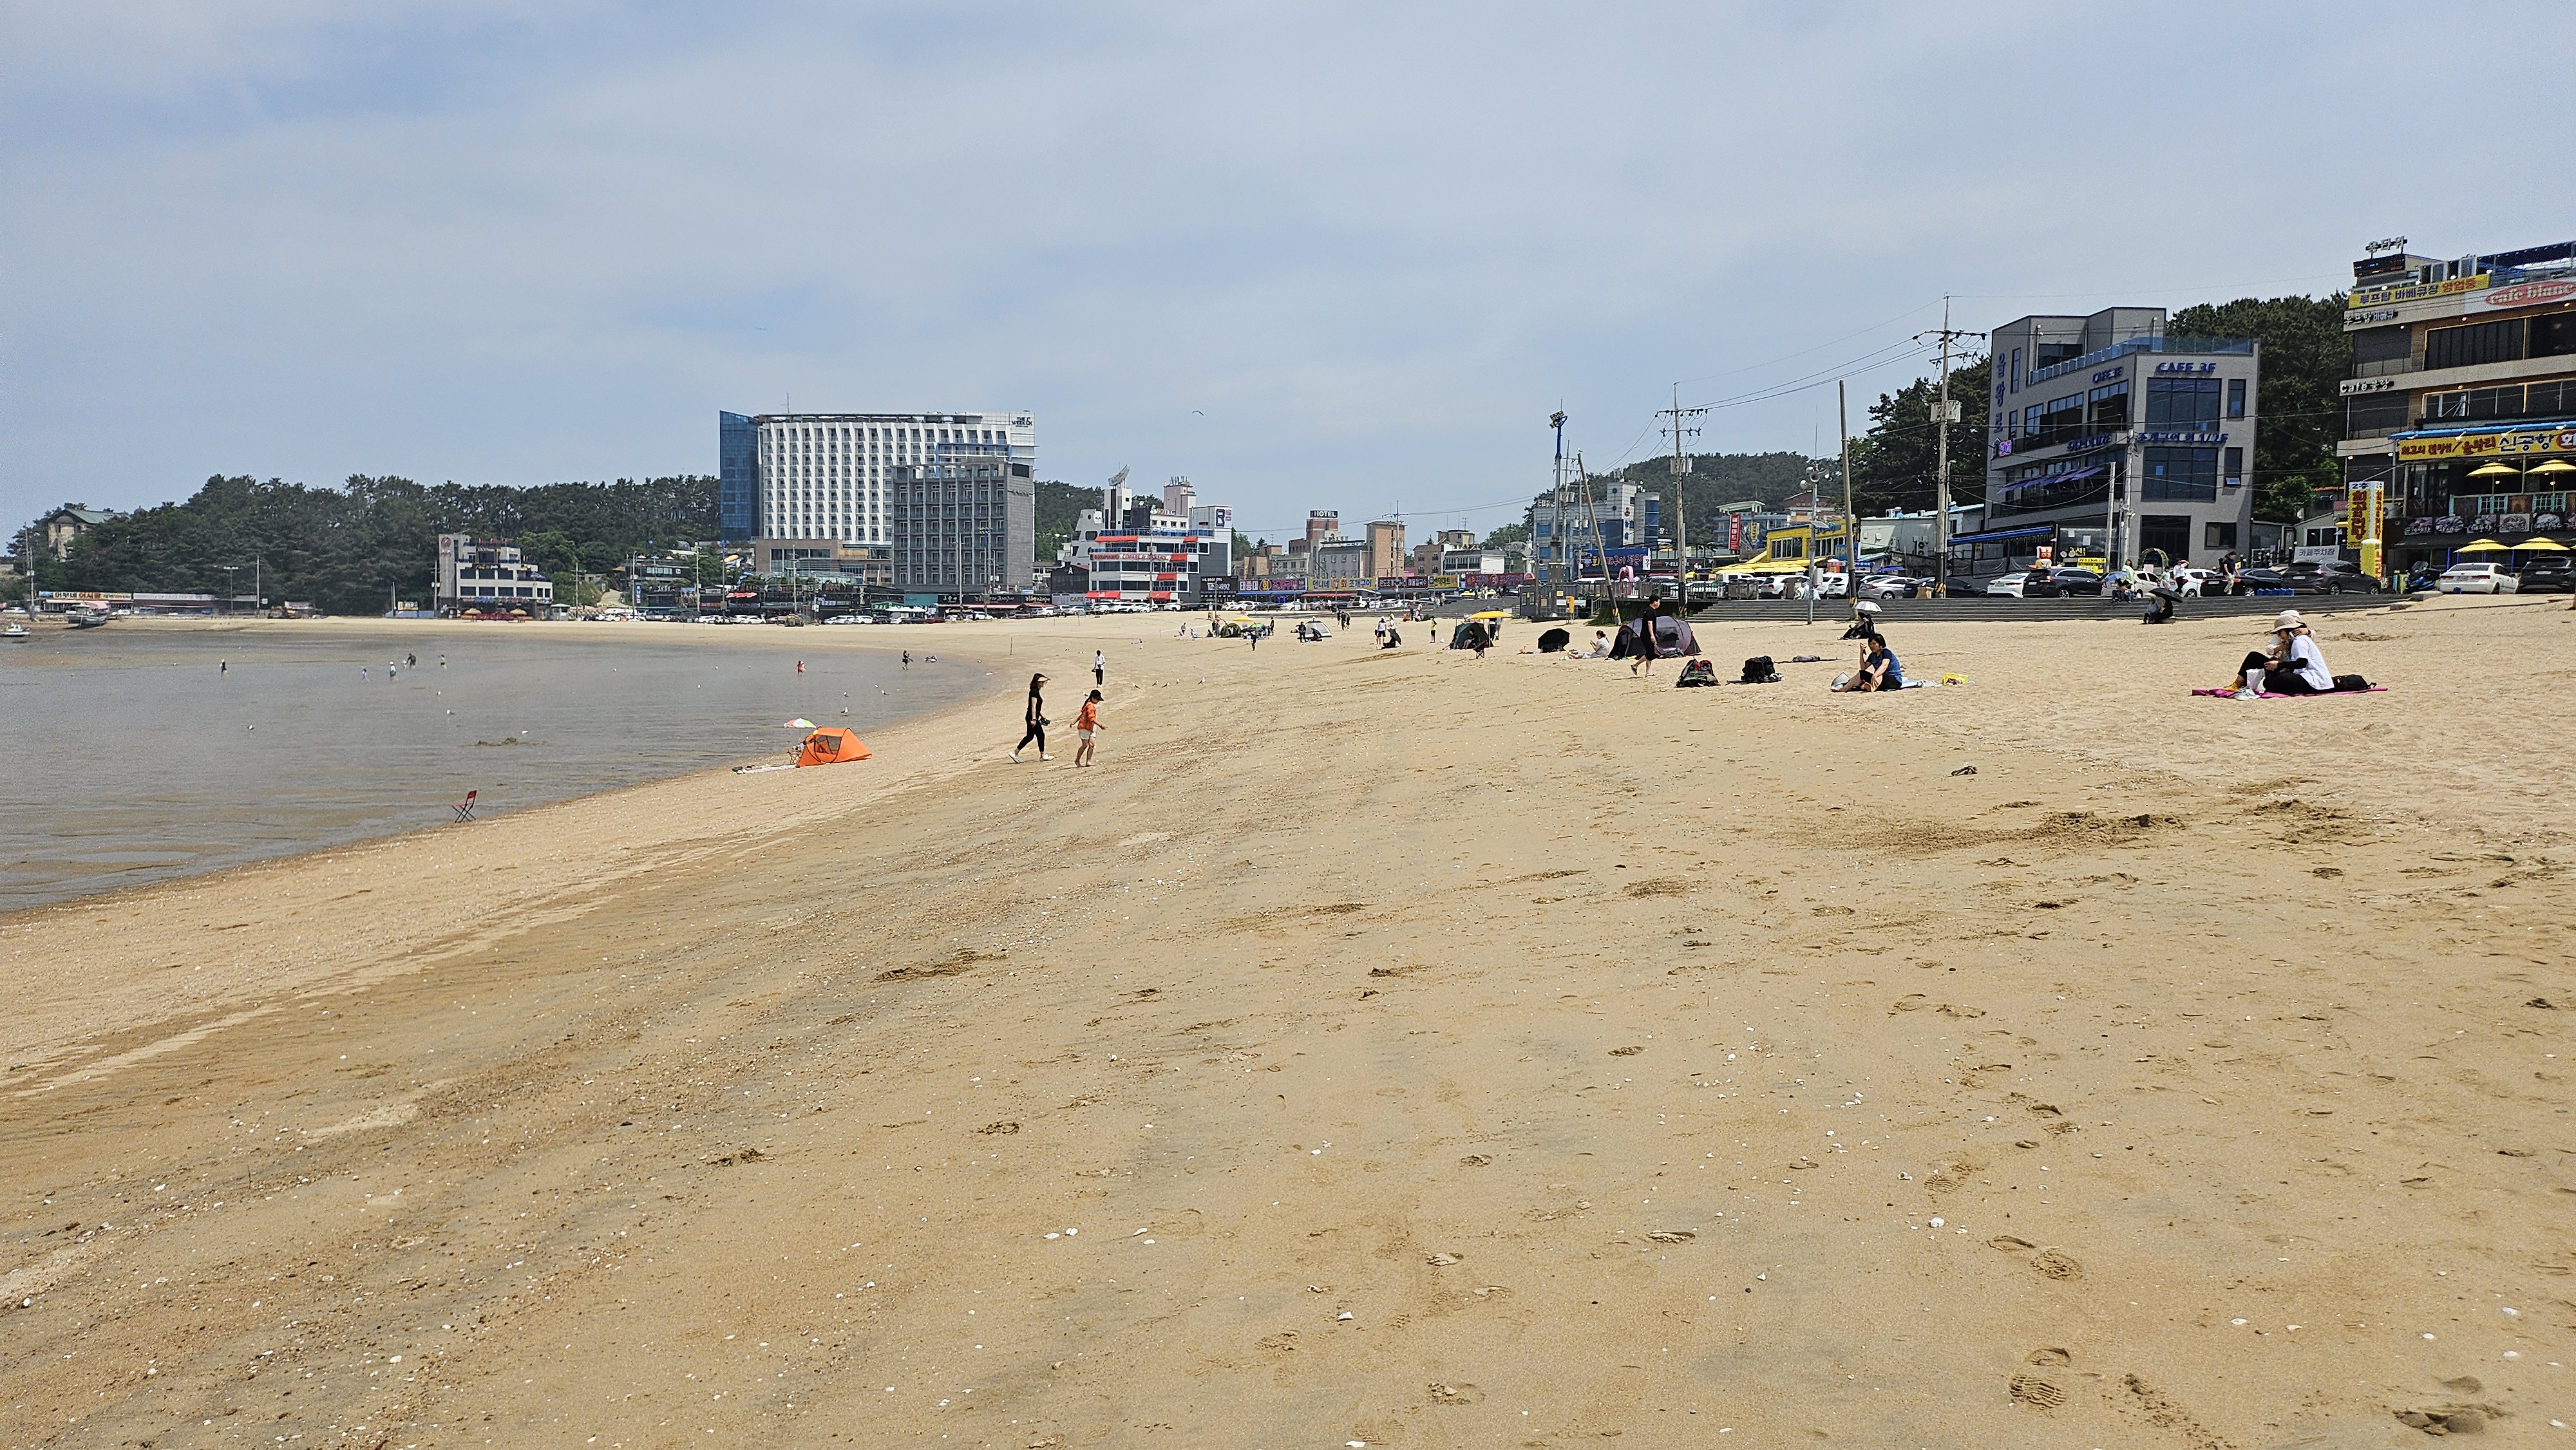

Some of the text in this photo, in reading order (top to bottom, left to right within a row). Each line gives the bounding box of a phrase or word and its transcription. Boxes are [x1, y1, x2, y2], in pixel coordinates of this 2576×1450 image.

[2443, 278, 2476, 293] 영업중
[2344, 312, 2372, 326] 루프탑
[2157, 362, 2217, 373] CAFE 3F
[2499, 433, 2555, 453] 신공항
[1239, 581, 1258, 591] 태종대
[1312, 579, 1330, 589] 언니네
[1349, 578, 1372, 588] 조개구이
